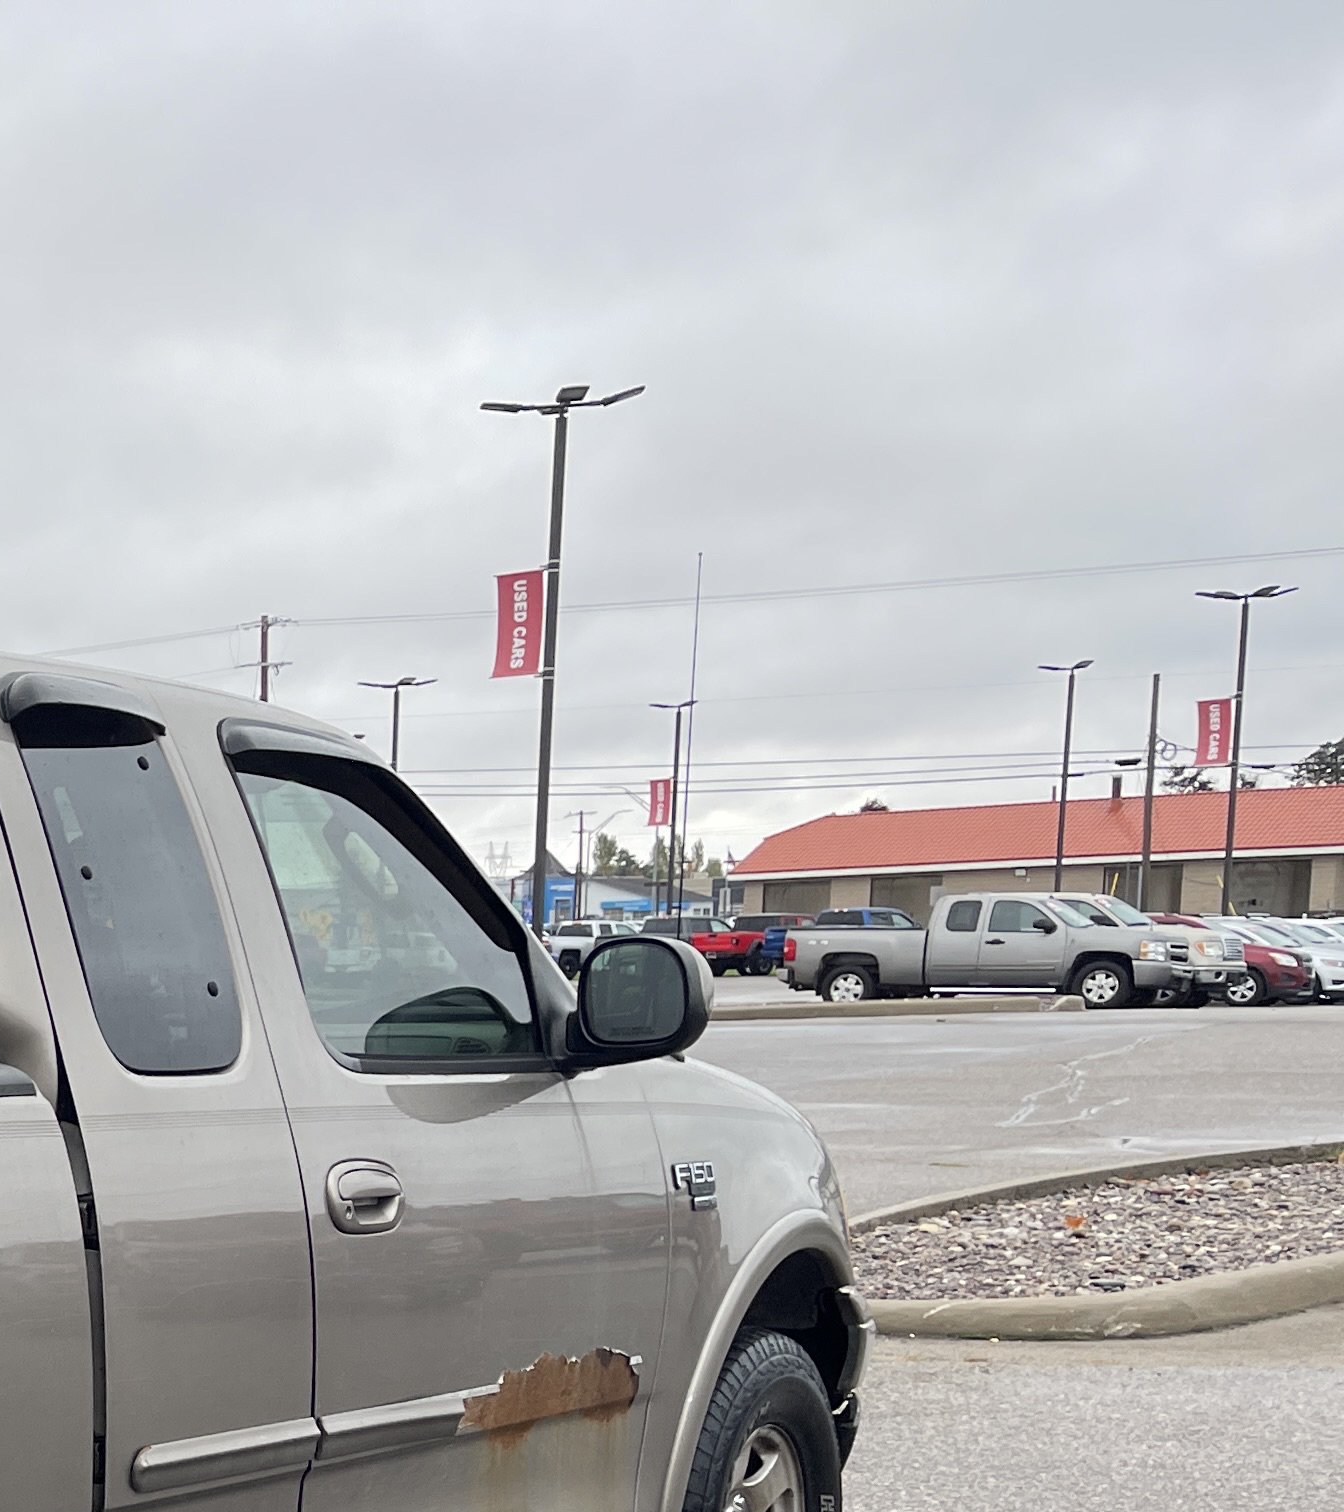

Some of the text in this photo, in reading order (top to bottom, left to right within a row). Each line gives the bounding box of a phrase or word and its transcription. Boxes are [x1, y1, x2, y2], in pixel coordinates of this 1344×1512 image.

[510, 579, 527, 669] USED CARS
[1207, 703, 1221, 760] USED CARS
[673, 1161, 715, 1189] F150
